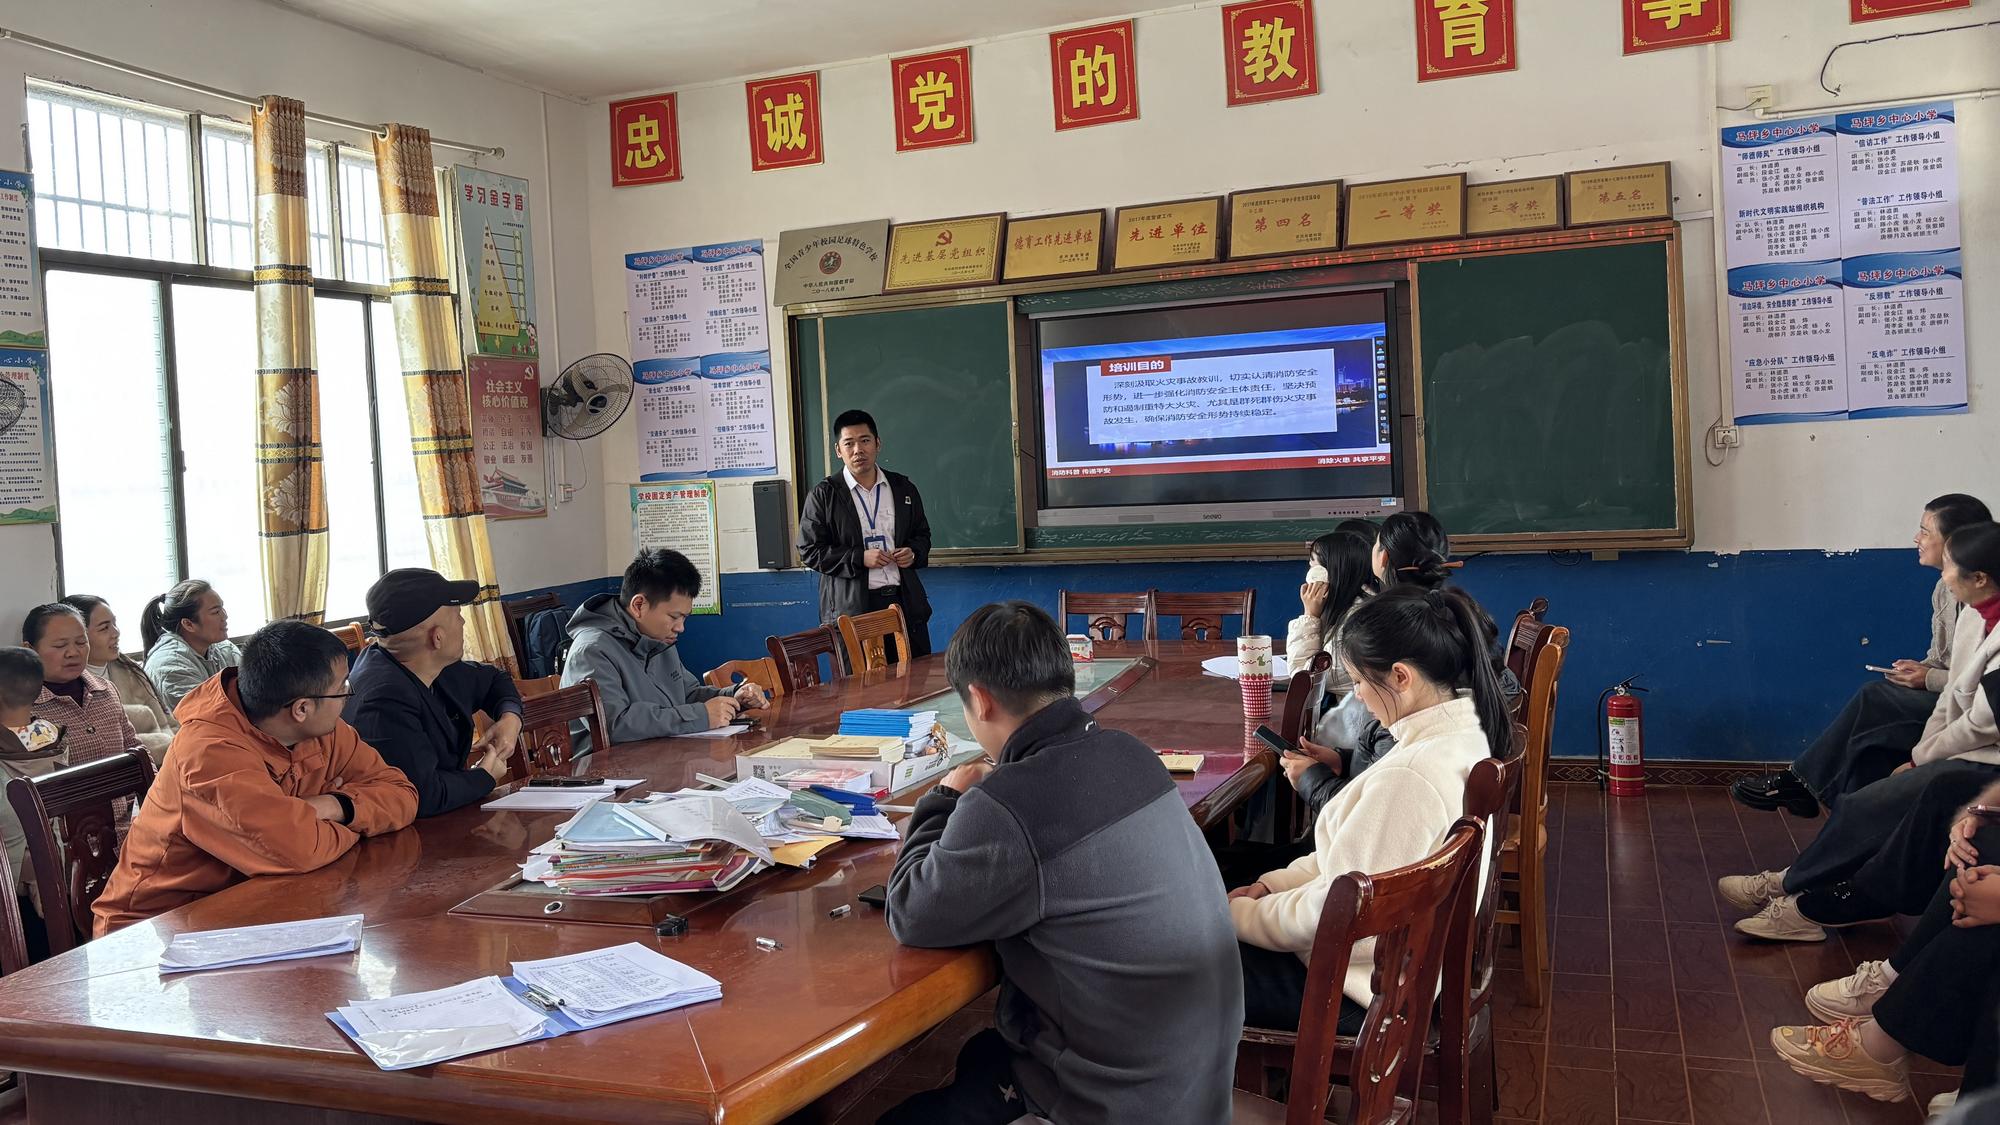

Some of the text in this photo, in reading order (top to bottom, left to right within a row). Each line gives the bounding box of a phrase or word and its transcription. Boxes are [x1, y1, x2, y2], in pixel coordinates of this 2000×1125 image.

[625, 0, 1489, 169] 忠 诚 党 的 教 育
[1851, 109, 1937, 128] 马坪乡中心小学
[1736, 123, 1820, 141] 马坪乡中心小学
[464, 184, 524, 211] 学习金字塔
[1599, 190, 1642, 205] 第五名
[1374, 202, 1444, 220] 二等奖
[1489, 200, 1540, 215] 三等奖
[1254, 212, 1313, 233] 第四名
[1014, 228, 1094, 250] 德育工作先进单位
[1128, 222, 1208, 243] 先进单位
[1858, 265, 1945, 281] 马坪乡中心小学
[1743, 275, 1826, 291] 马坪乡中心小学
[1108, 360, 1164, 373] 培训目的
[486, 380, 523, 394] 社会主义
[482, 395, 529, 409] 核心价值观
